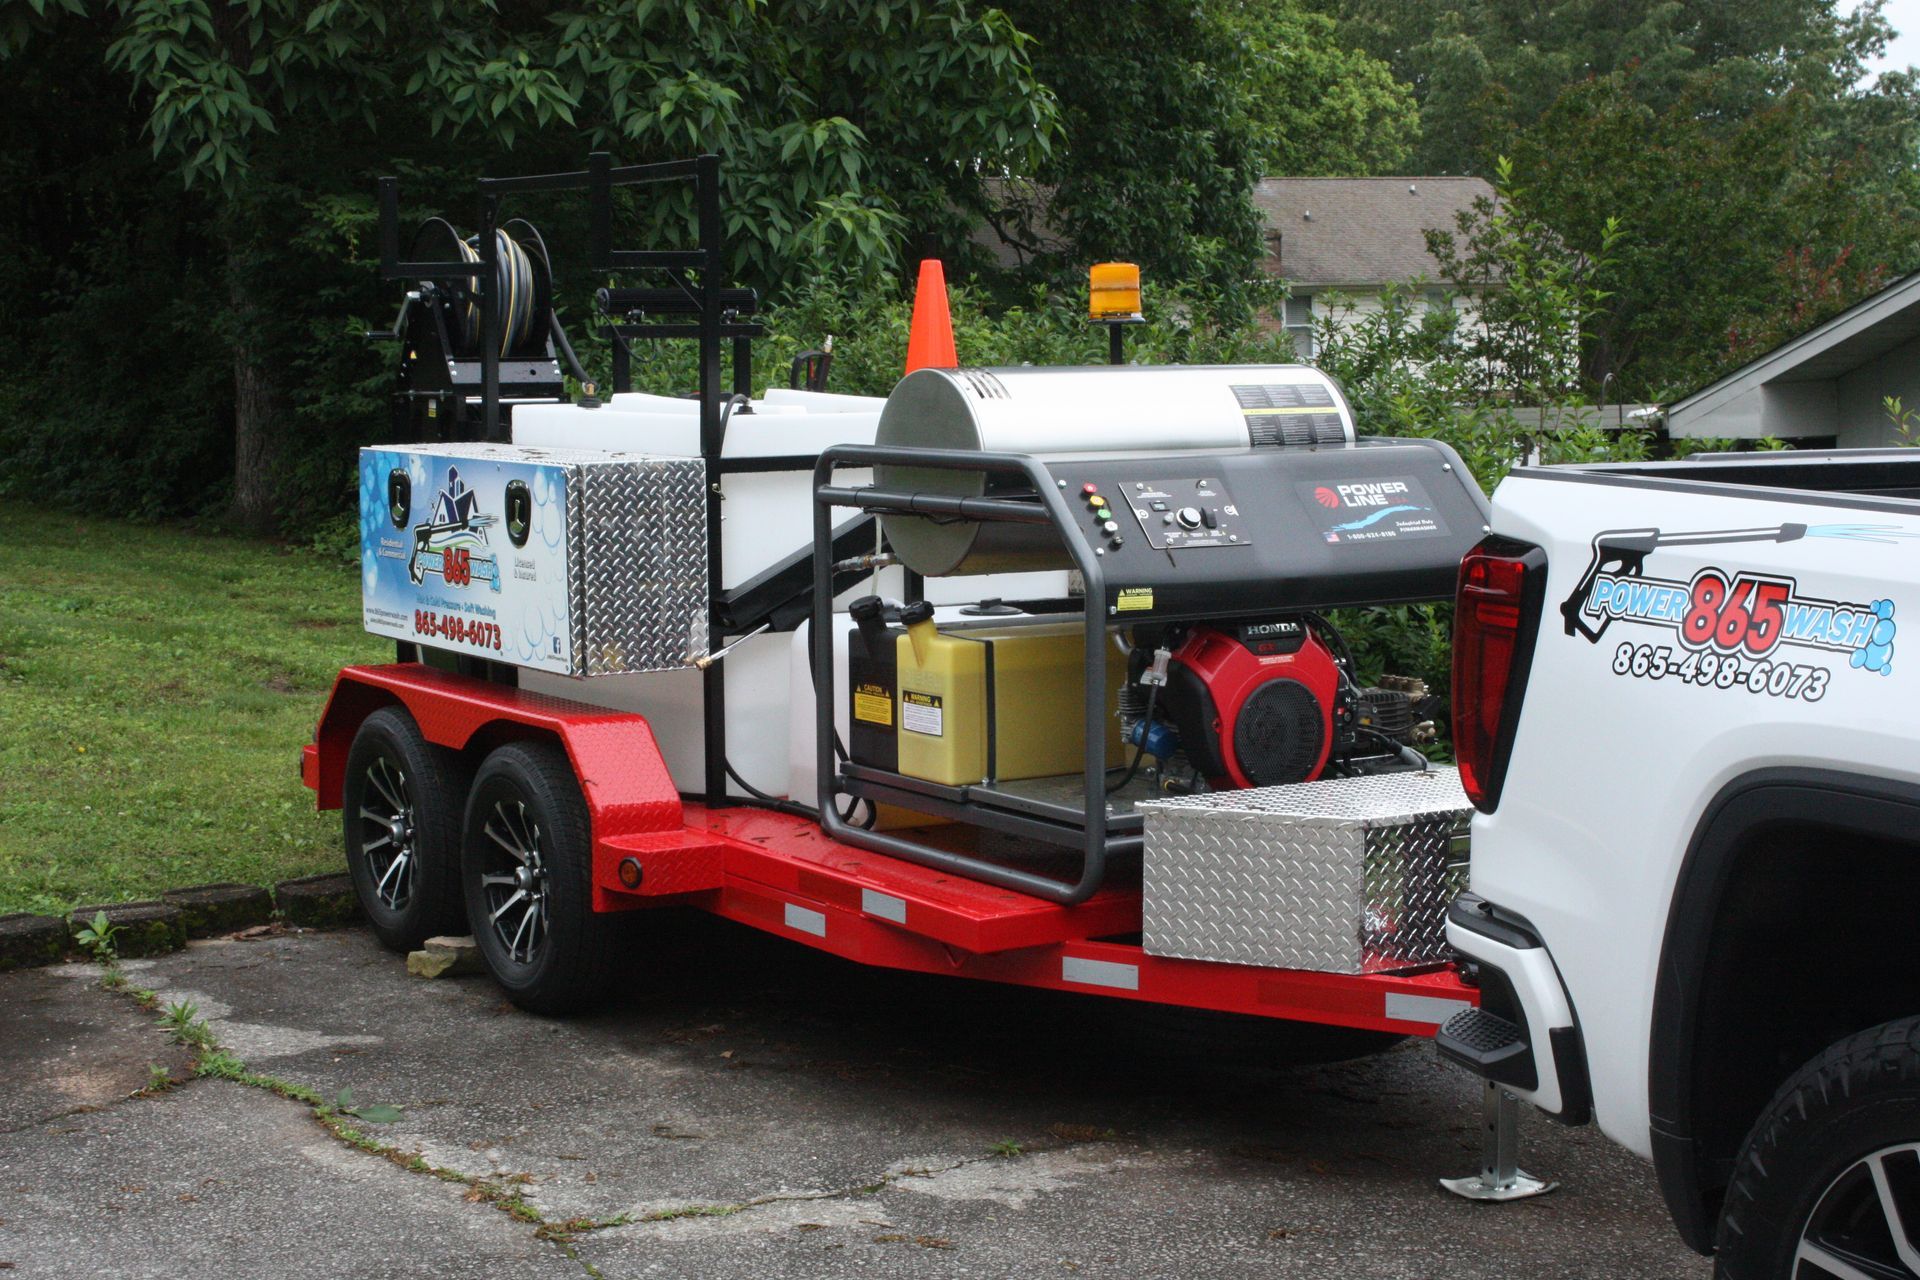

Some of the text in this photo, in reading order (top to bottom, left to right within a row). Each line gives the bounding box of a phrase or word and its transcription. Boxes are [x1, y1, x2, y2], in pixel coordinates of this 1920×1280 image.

[1337, 482, 1409, 497] POWER
[1343, 494, 1389, 508] LINE
[416, 546, 493, 586] POWER 865 WASH
[1125, 587, 1153, 595] WARNING
[1591, 573, 1879, 652] POWER 865 WASH
[415, 608, 502, 651] 865-498-6073
[1247, 622, 1300, 635] HONDA
[1612, 640, 1831, 703] 865-498-6073
